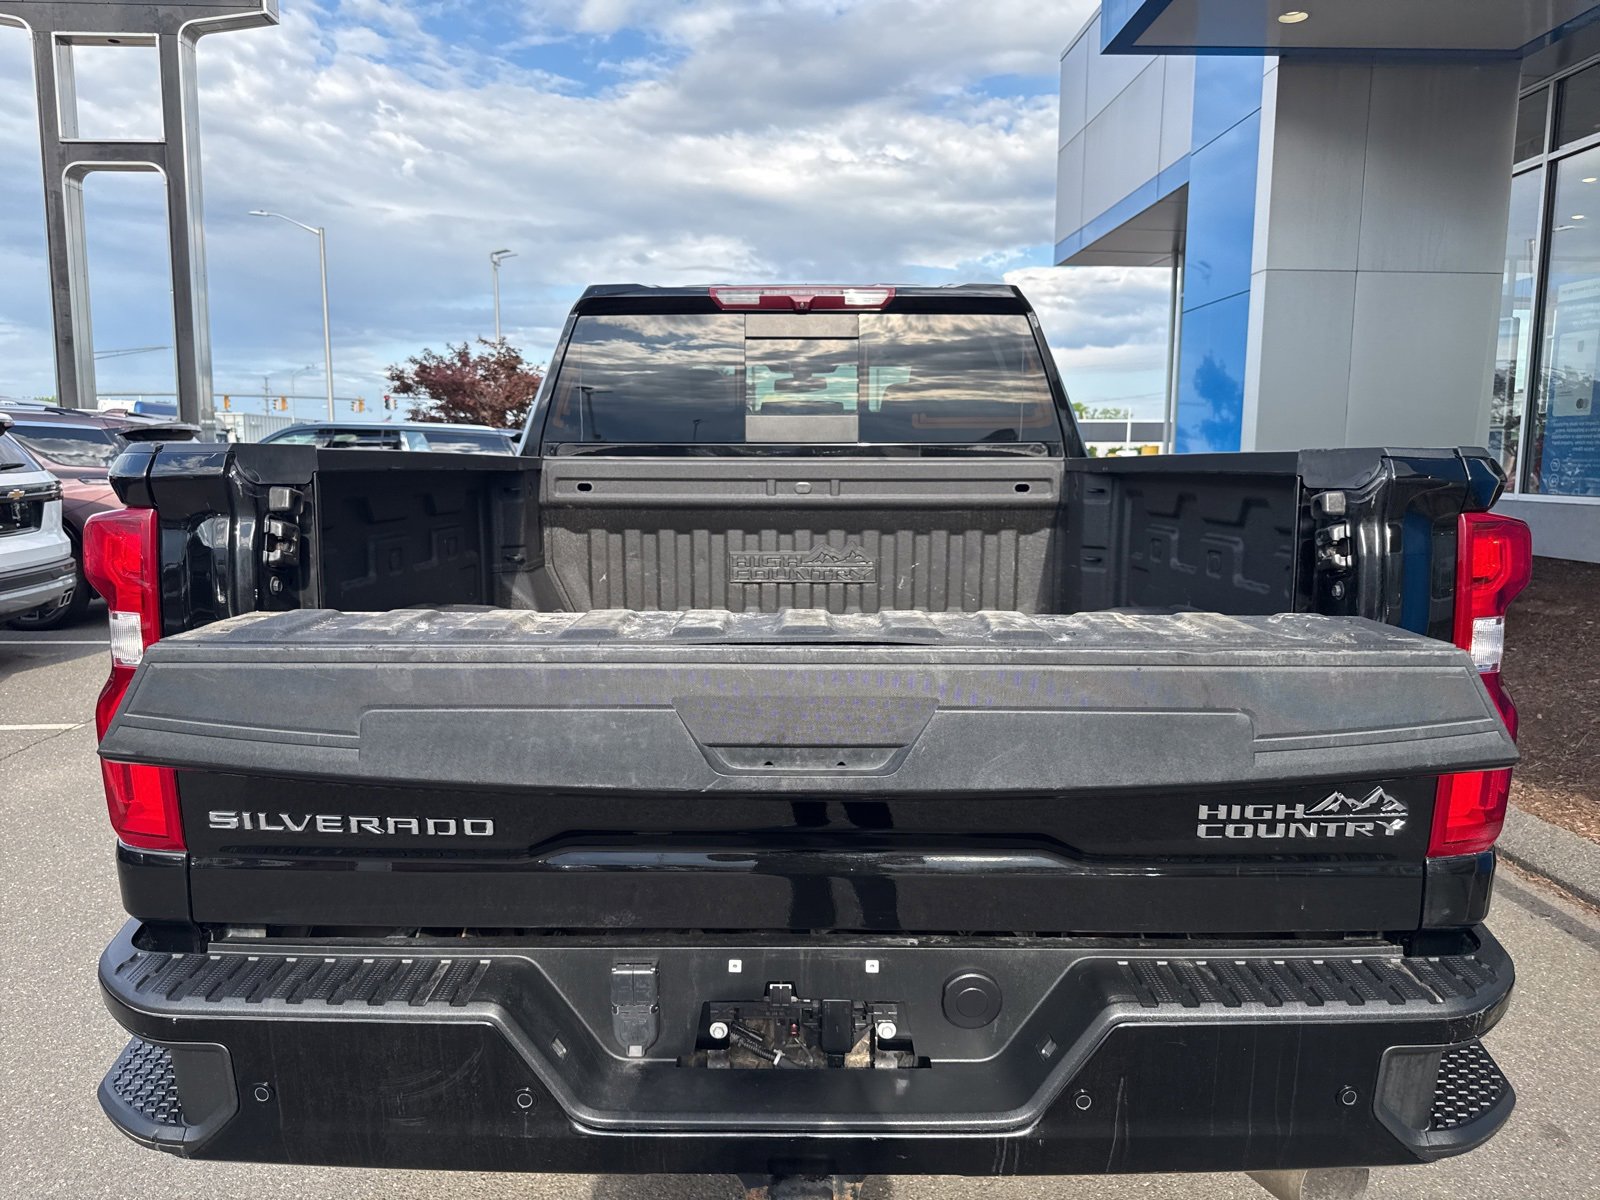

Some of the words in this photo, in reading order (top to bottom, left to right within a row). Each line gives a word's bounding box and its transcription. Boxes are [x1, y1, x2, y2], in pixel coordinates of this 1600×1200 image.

[731, 555, 802, 567] HIGH
[731, 567, 874, 581] COUNTRY
[1198, 804, 1306, 819] HIGH
[208, 811, 495, 836] SILVERADO
[1196, 819, 1406, 838] COUNTRY
